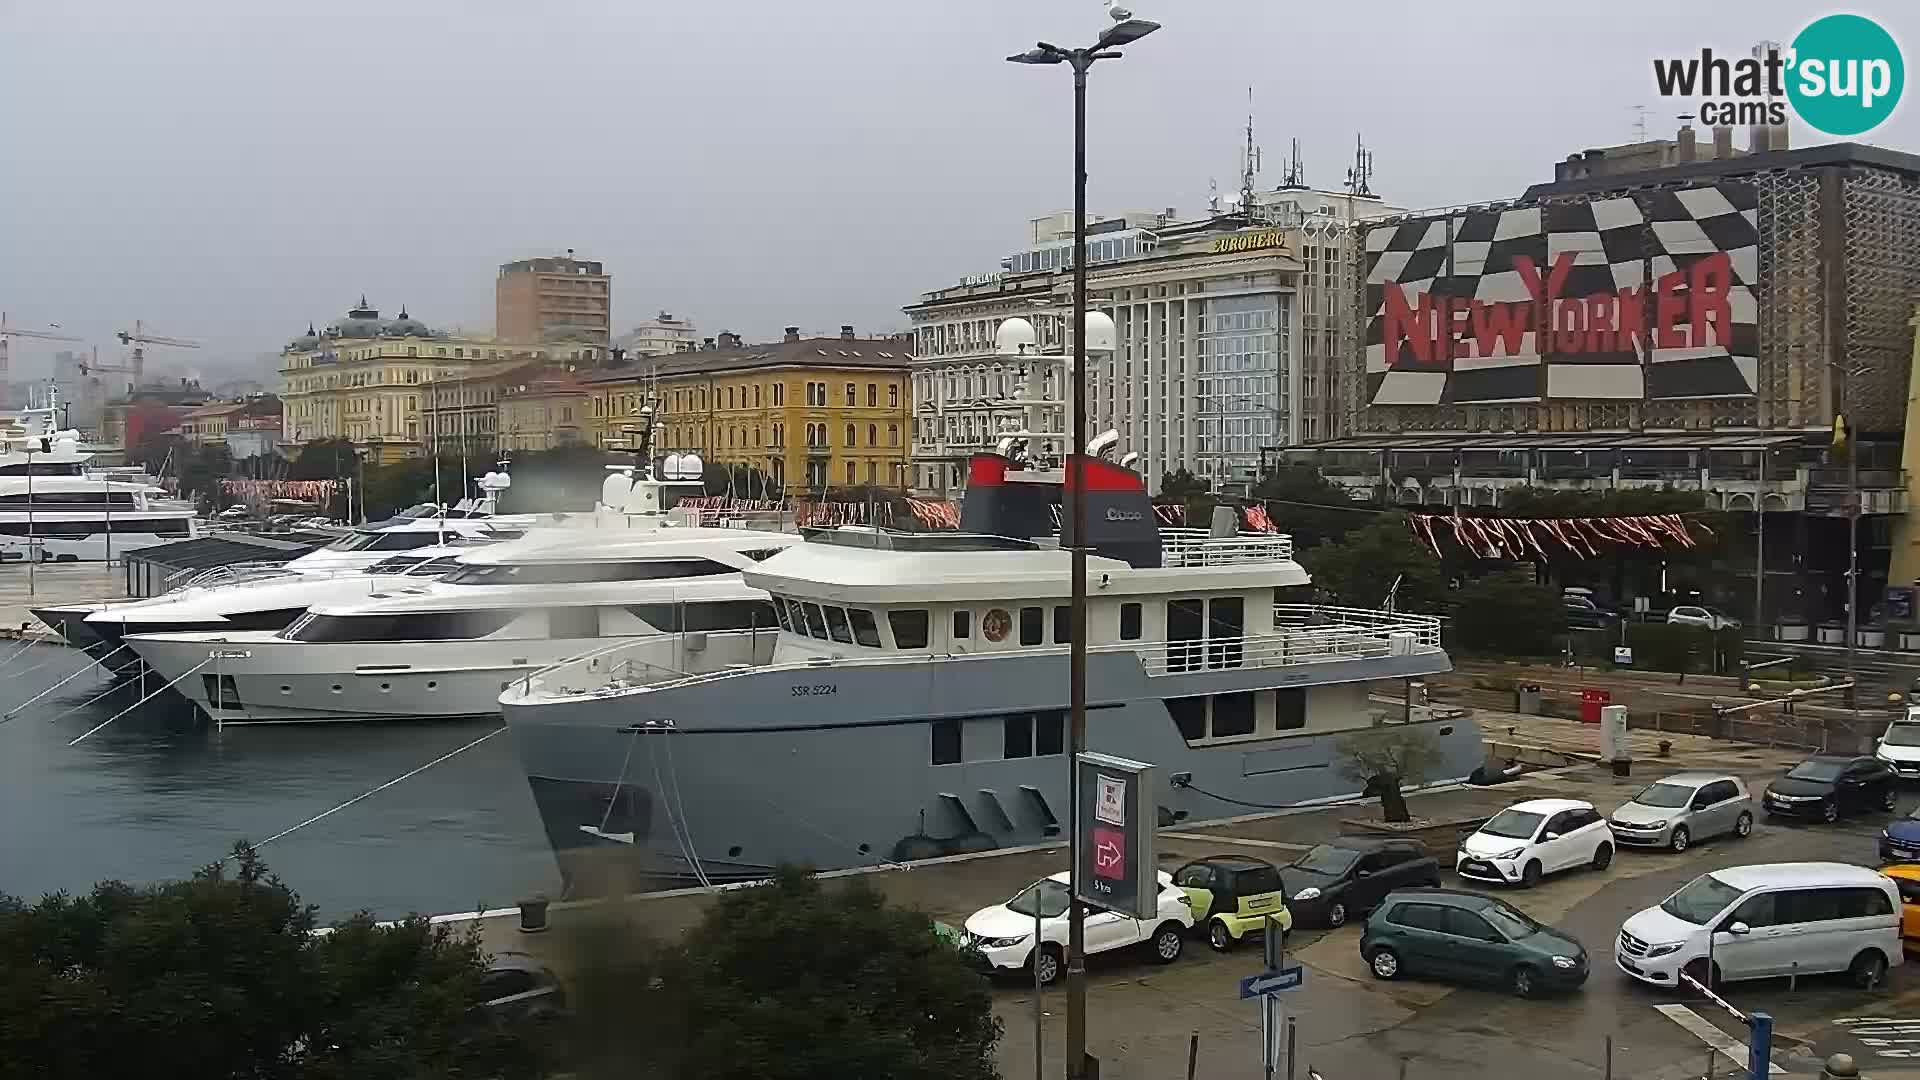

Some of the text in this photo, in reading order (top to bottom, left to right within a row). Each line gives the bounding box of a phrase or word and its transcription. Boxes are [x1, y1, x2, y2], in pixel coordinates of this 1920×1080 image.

[1384, 250, 1732, 364] NEW YORKER
[791, 685, 810, 697] SSR
